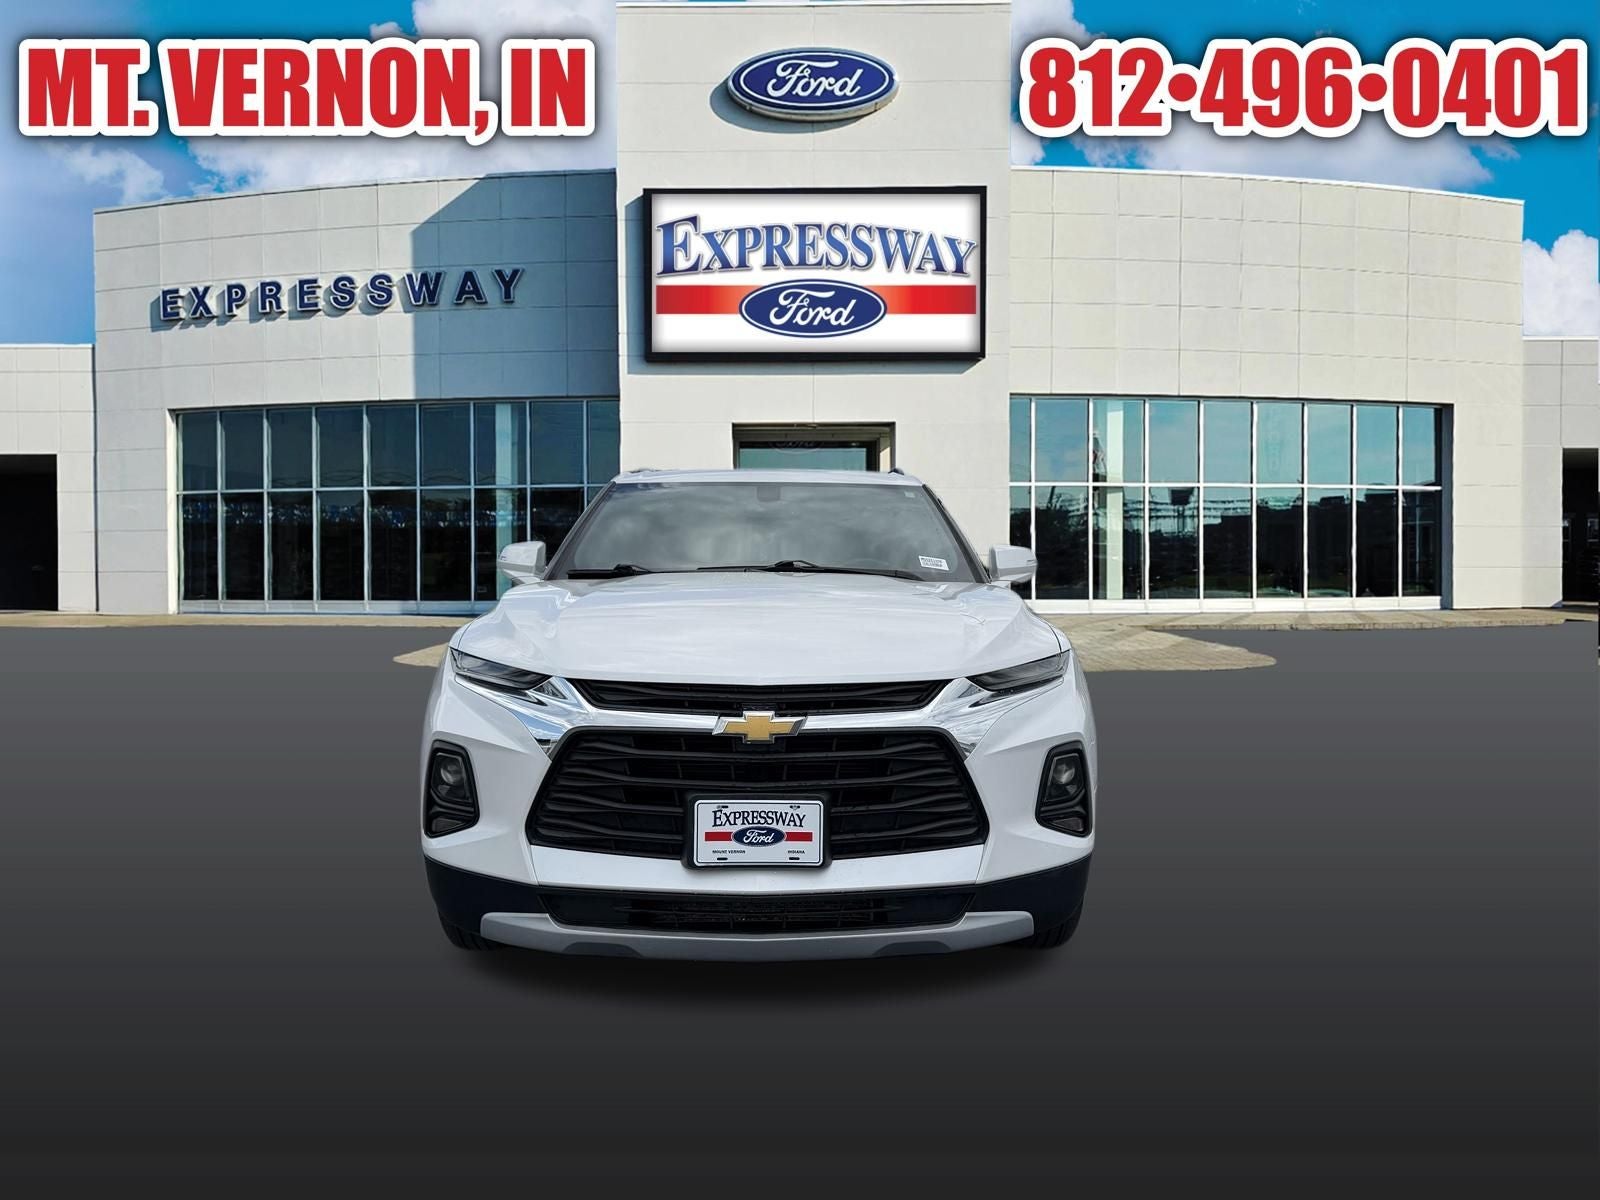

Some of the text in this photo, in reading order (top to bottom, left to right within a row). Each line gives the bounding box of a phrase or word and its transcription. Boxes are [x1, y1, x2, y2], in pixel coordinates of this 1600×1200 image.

[766, 59, 864, 97] Ford
[159, 268, 526, 321] EXPRESSWAY
[769, 288, 856, 326] Ford
[743, 829, 775, 844] Ford
